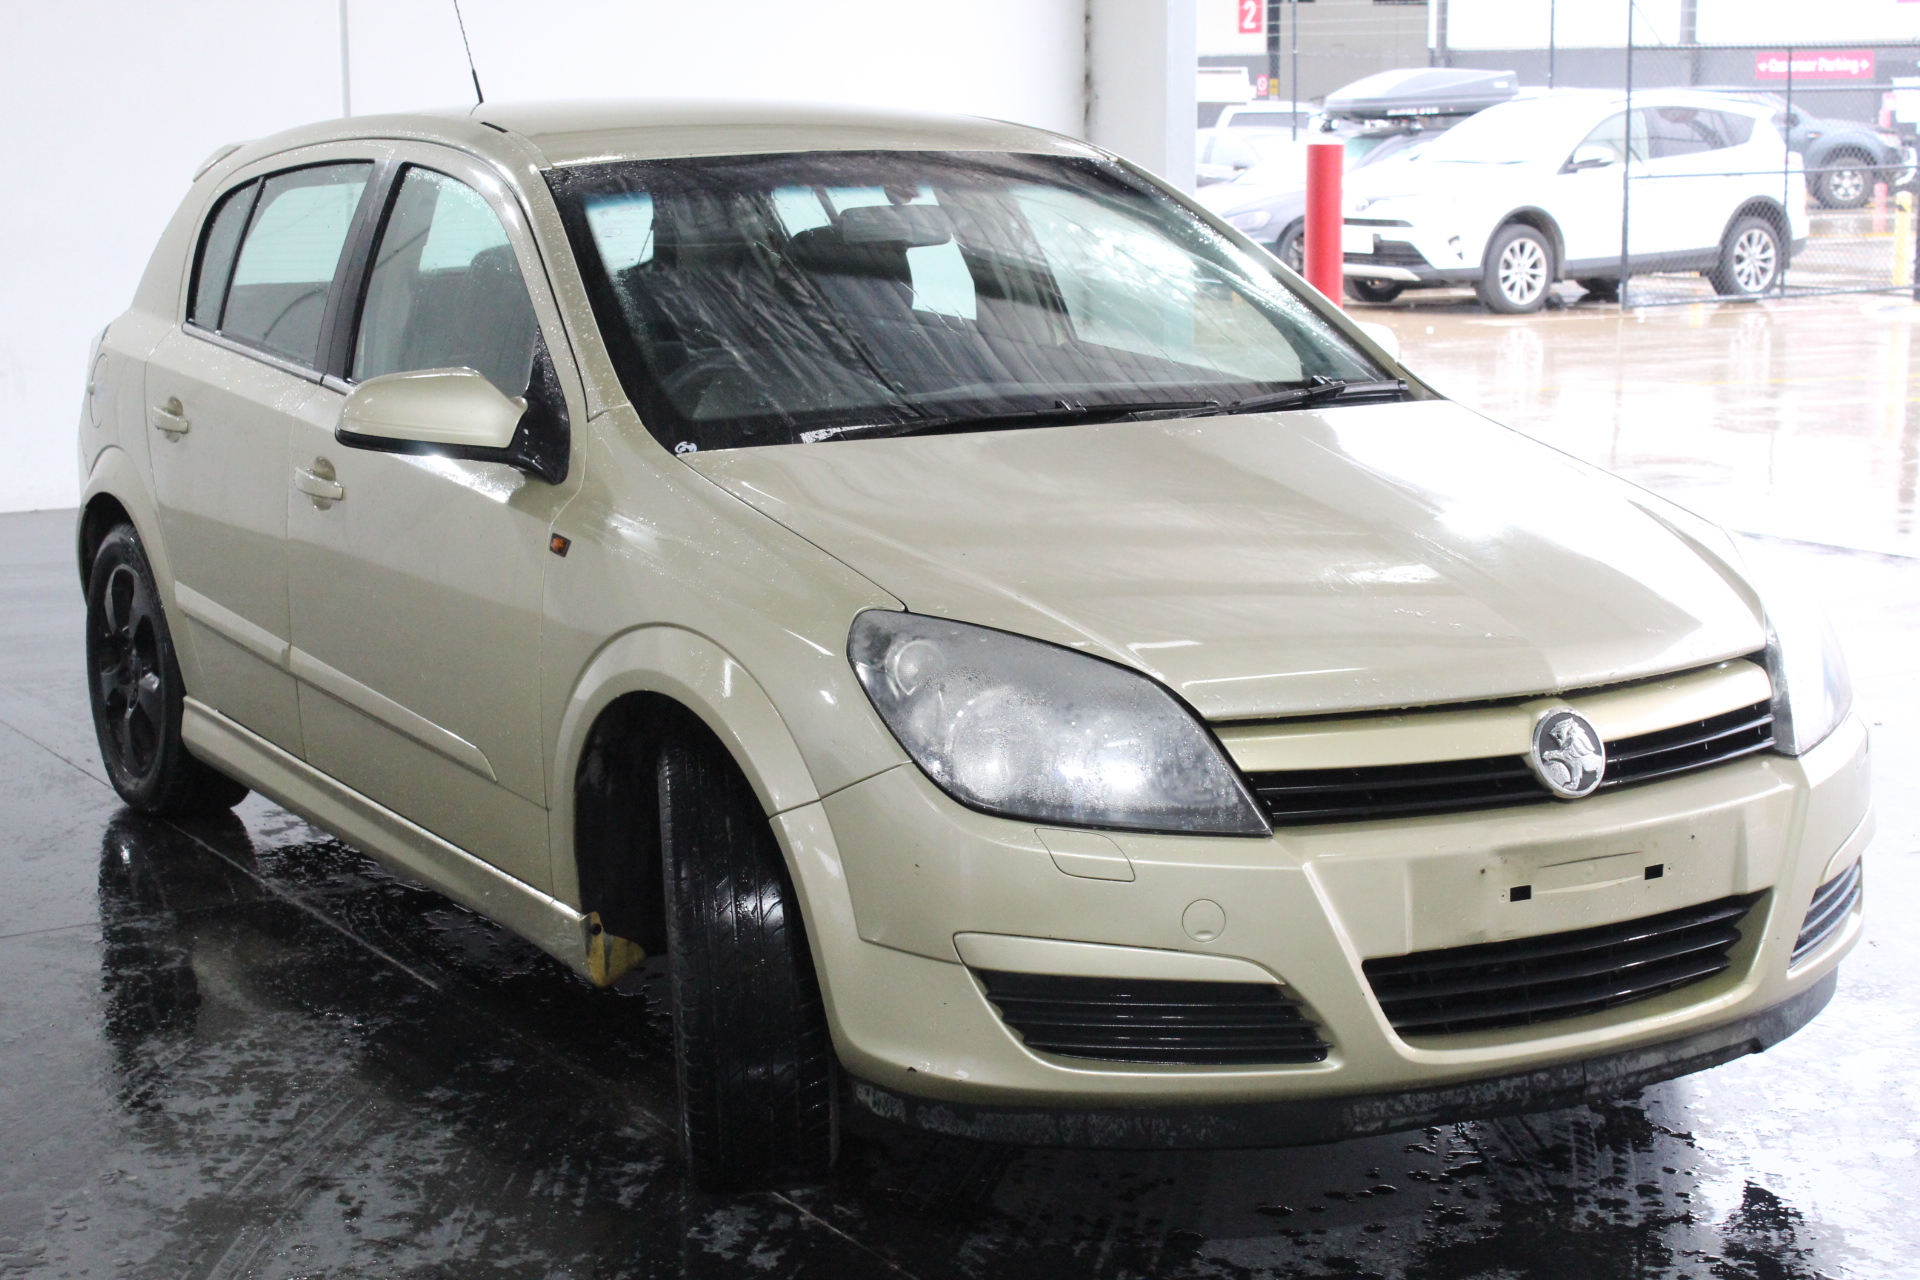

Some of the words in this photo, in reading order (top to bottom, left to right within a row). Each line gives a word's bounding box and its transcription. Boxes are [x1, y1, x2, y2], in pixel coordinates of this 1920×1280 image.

[1243, 0, 1257, 29] 2
[1768, 58, 1817, 72] Cusomer
[1818, 57, 1859, 74] Parking
